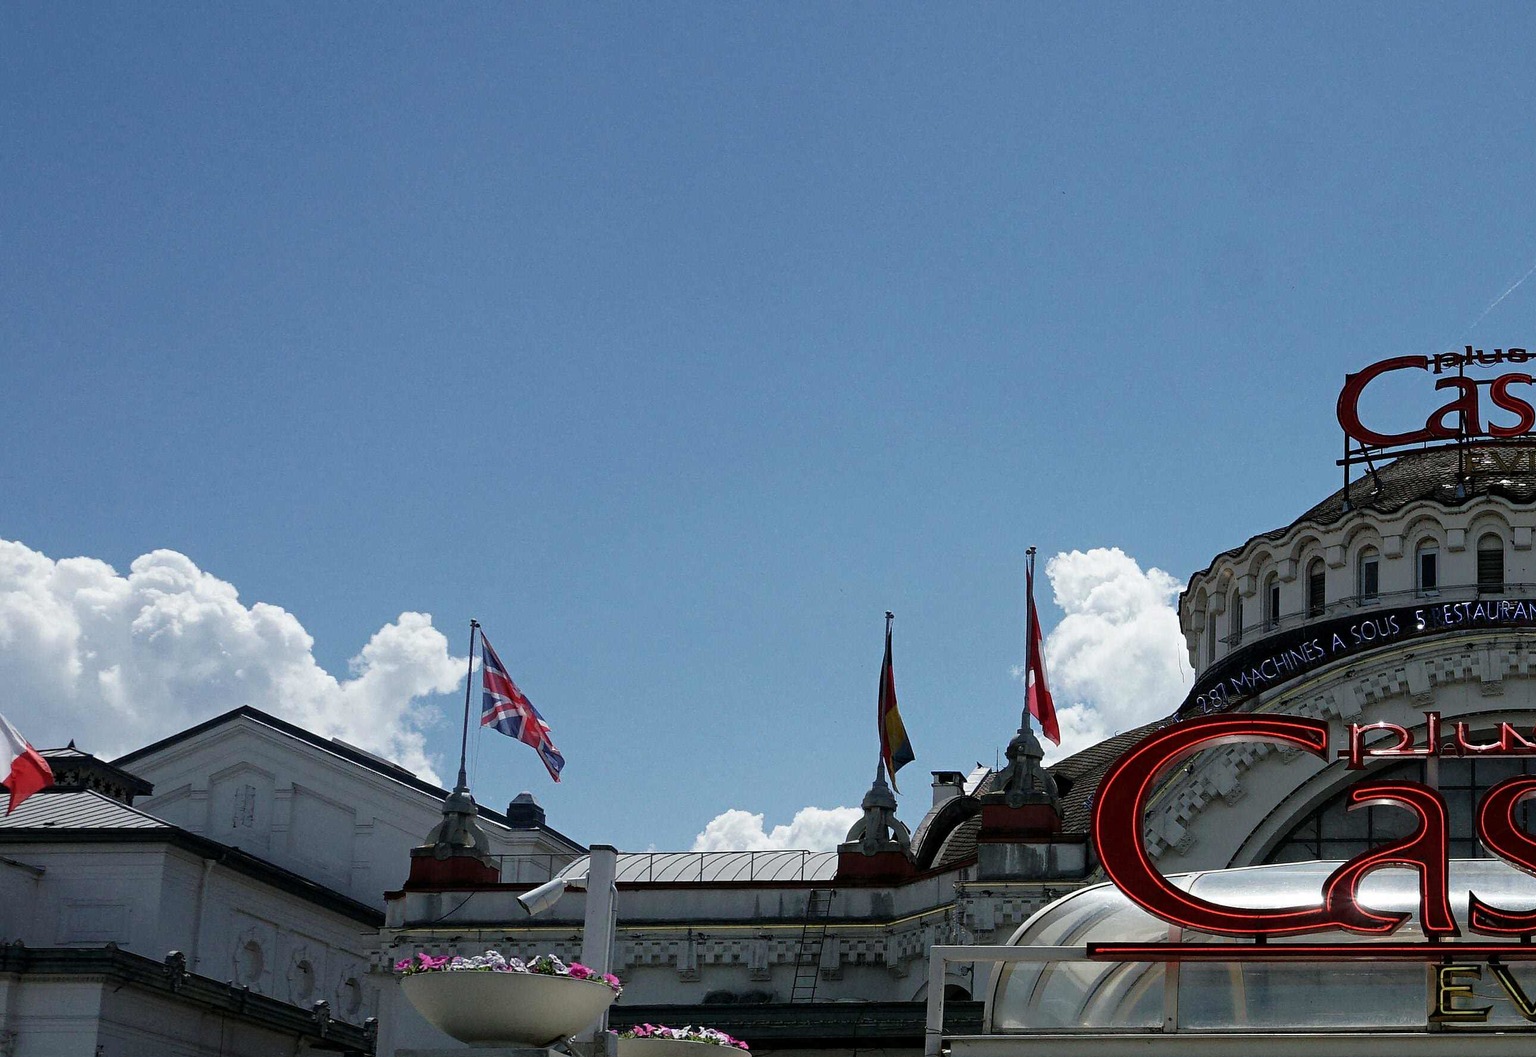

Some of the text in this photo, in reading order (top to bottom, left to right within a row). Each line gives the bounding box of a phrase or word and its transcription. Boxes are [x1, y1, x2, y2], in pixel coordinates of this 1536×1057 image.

[1432, 345, 1529, 374] plus
[1196, 682, 1230, 716] 287
[1231, 638, 1325, 697] MACHINES
[1331, 632, 1347, 653] A
[1350, 614, 1401, 646] SOUS
[1414, 608, 1426, 630] 5
